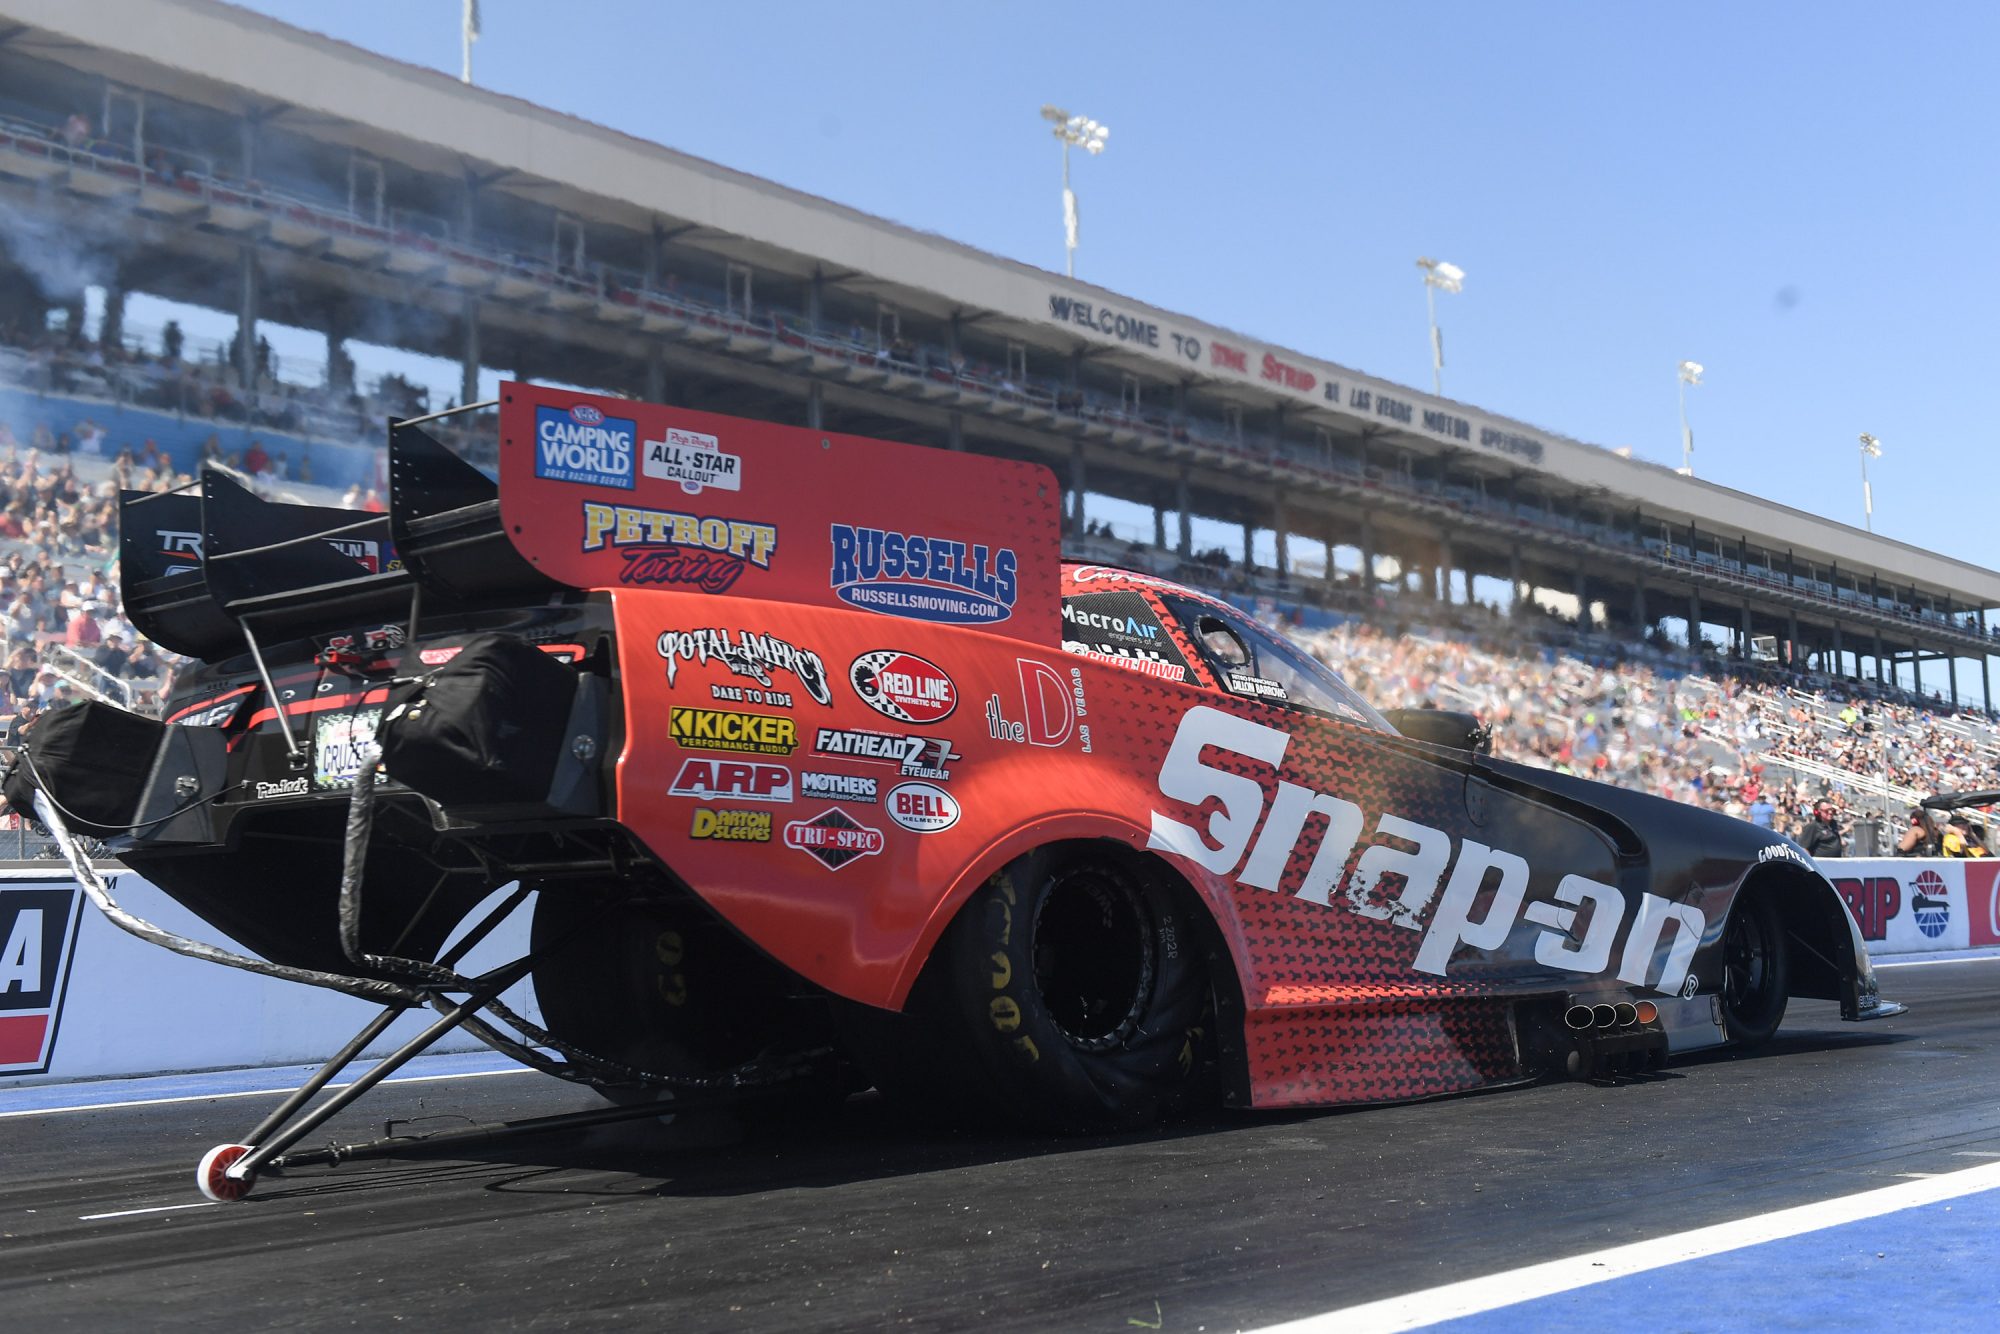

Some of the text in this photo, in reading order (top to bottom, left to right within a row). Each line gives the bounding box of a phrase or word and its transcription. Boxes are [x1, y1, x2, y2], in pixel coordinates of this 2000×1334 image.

[1050, 294, 1159, 349] WELCOME
[1170, 332, 1201, 361] TO
[540, 420, 630, 453] CAMPING
[541, 440, 631, 476] WORLD
[651, 445, 736, 475] ALL STAR
[667, 466, 718, 484] CALLOUT
[156, 530, 205, 561] TR
[583, 502, 777, 569] PETROFF
[620, 547, 745, 594] Towing
[831, 523, 1017, 608] RUSSELLS
[851, 587, 999, 618] RUSSELLSMOVING.COM
[656, 628, 739, 689] TOTAL
[711, 686, 794, 707] DARE TO RIDE
[882, 671, 949, 702] RED LINE
[894, 695, 943, 709] SYNTHETIC OIL
[1232, 679, 1287, 699] DILLON BARROWS
[985, 657, 1075, 748] the D
[1070, 667, 1093, 753] LAS VEGAS
[694, 711, 795, 746] KICKER
[681, 737, 788, 754] PERFORMANCE AUDIO
[816, 729, 927, 767] FATHEADZ
[674, 760, 791, 796] ARP
[801, 771, 877, 796] MOTHERS
[901, 765, 950, 780] EYEWEAR
[896, 792, 949, 817] BELL
[902, 816, 944, 824] HELMETS
[714, 824, 771, 841] SLEEVES
